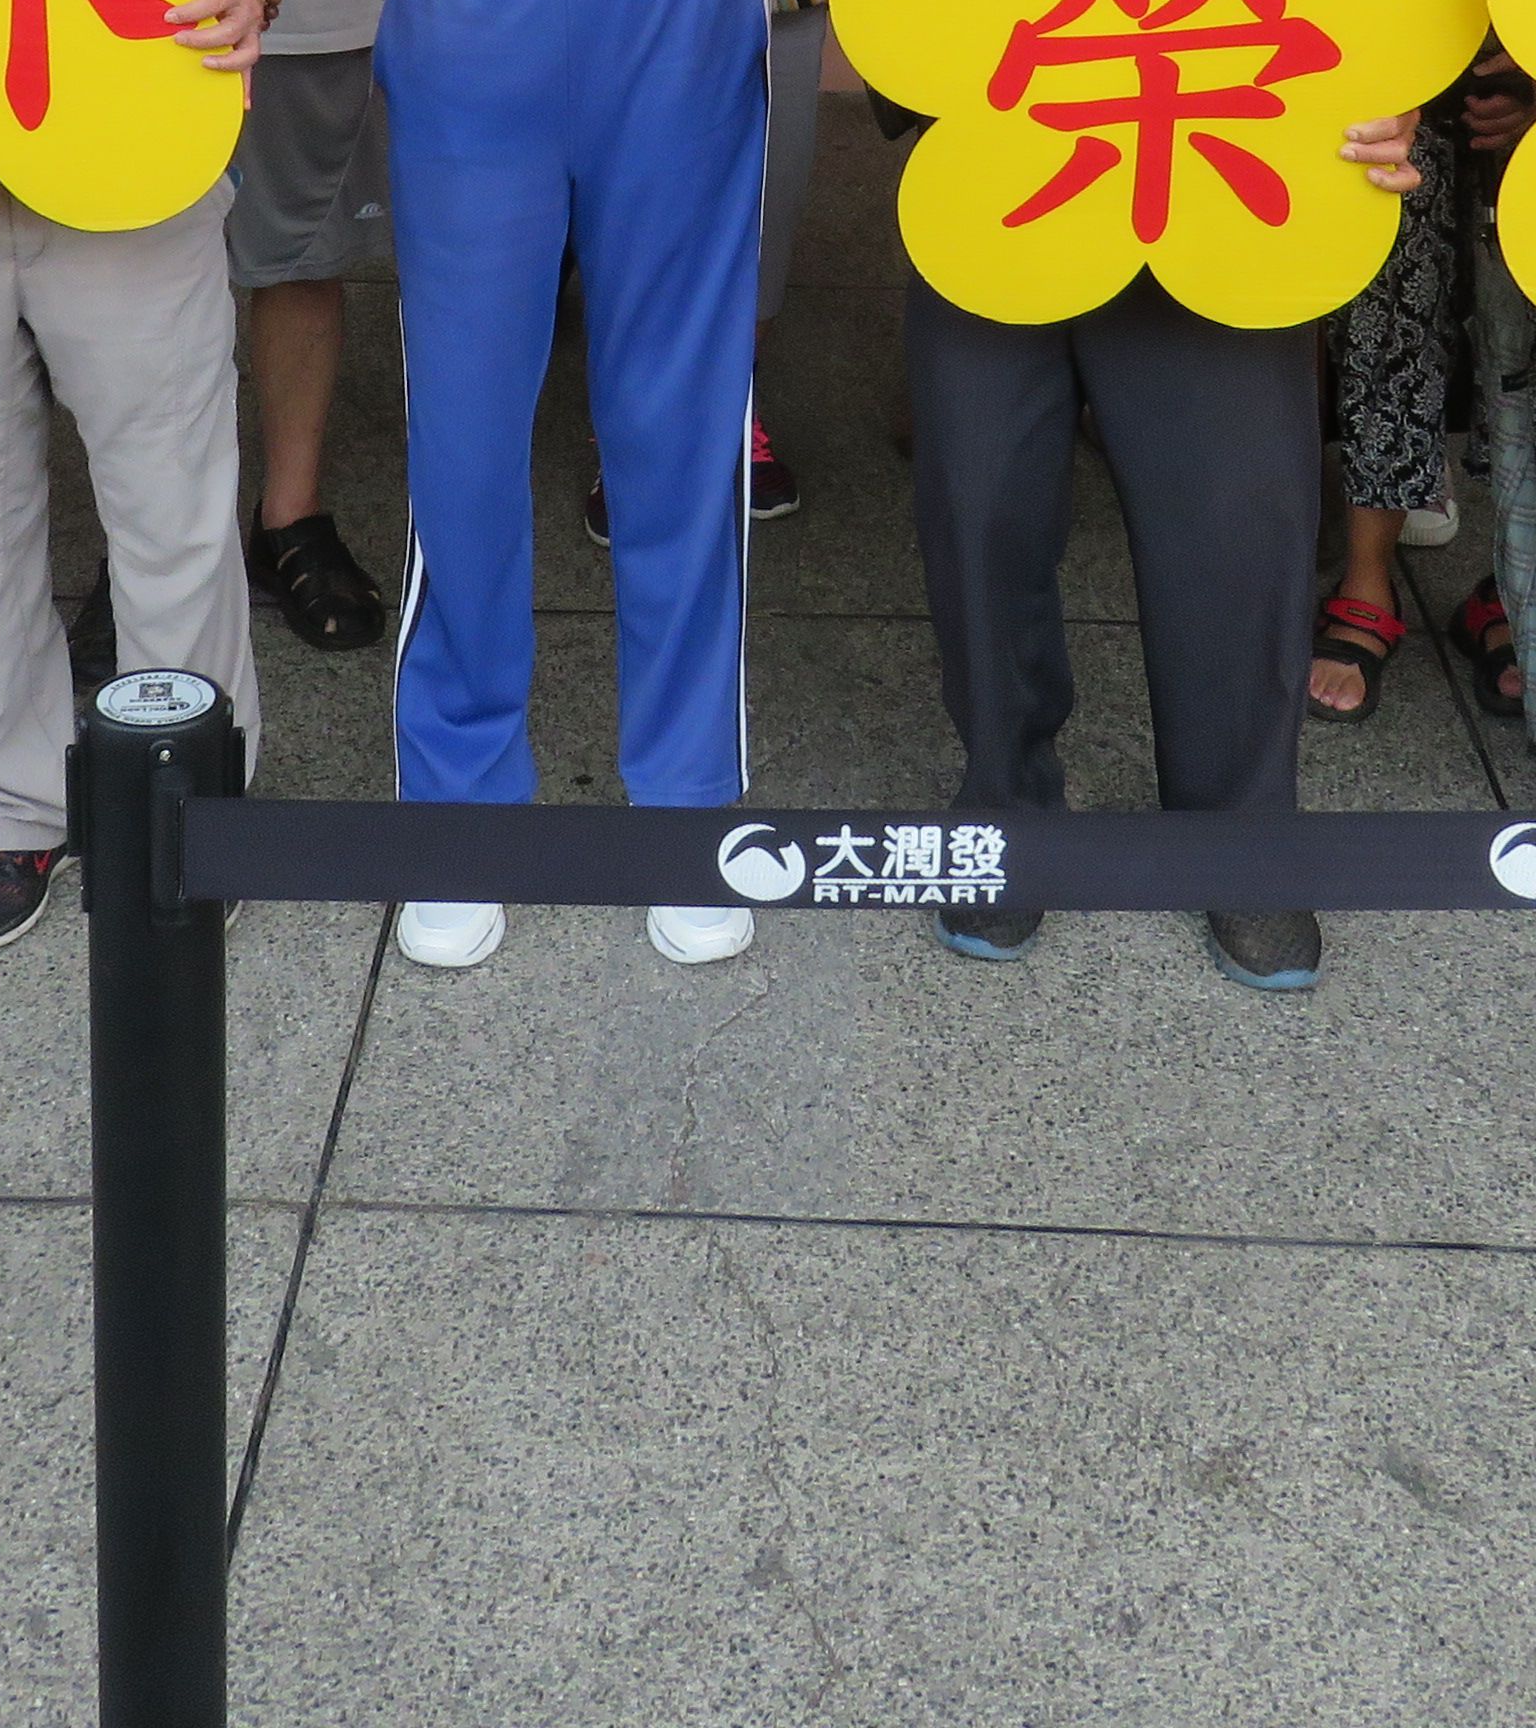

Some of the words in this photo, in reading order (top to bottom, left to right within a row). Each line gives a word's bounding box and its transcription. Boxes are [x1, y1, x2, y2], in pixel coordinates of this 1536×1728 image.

[814, 823, 1008, 878] 大潤發
[813, 884, 1005, 905] RT-MART
